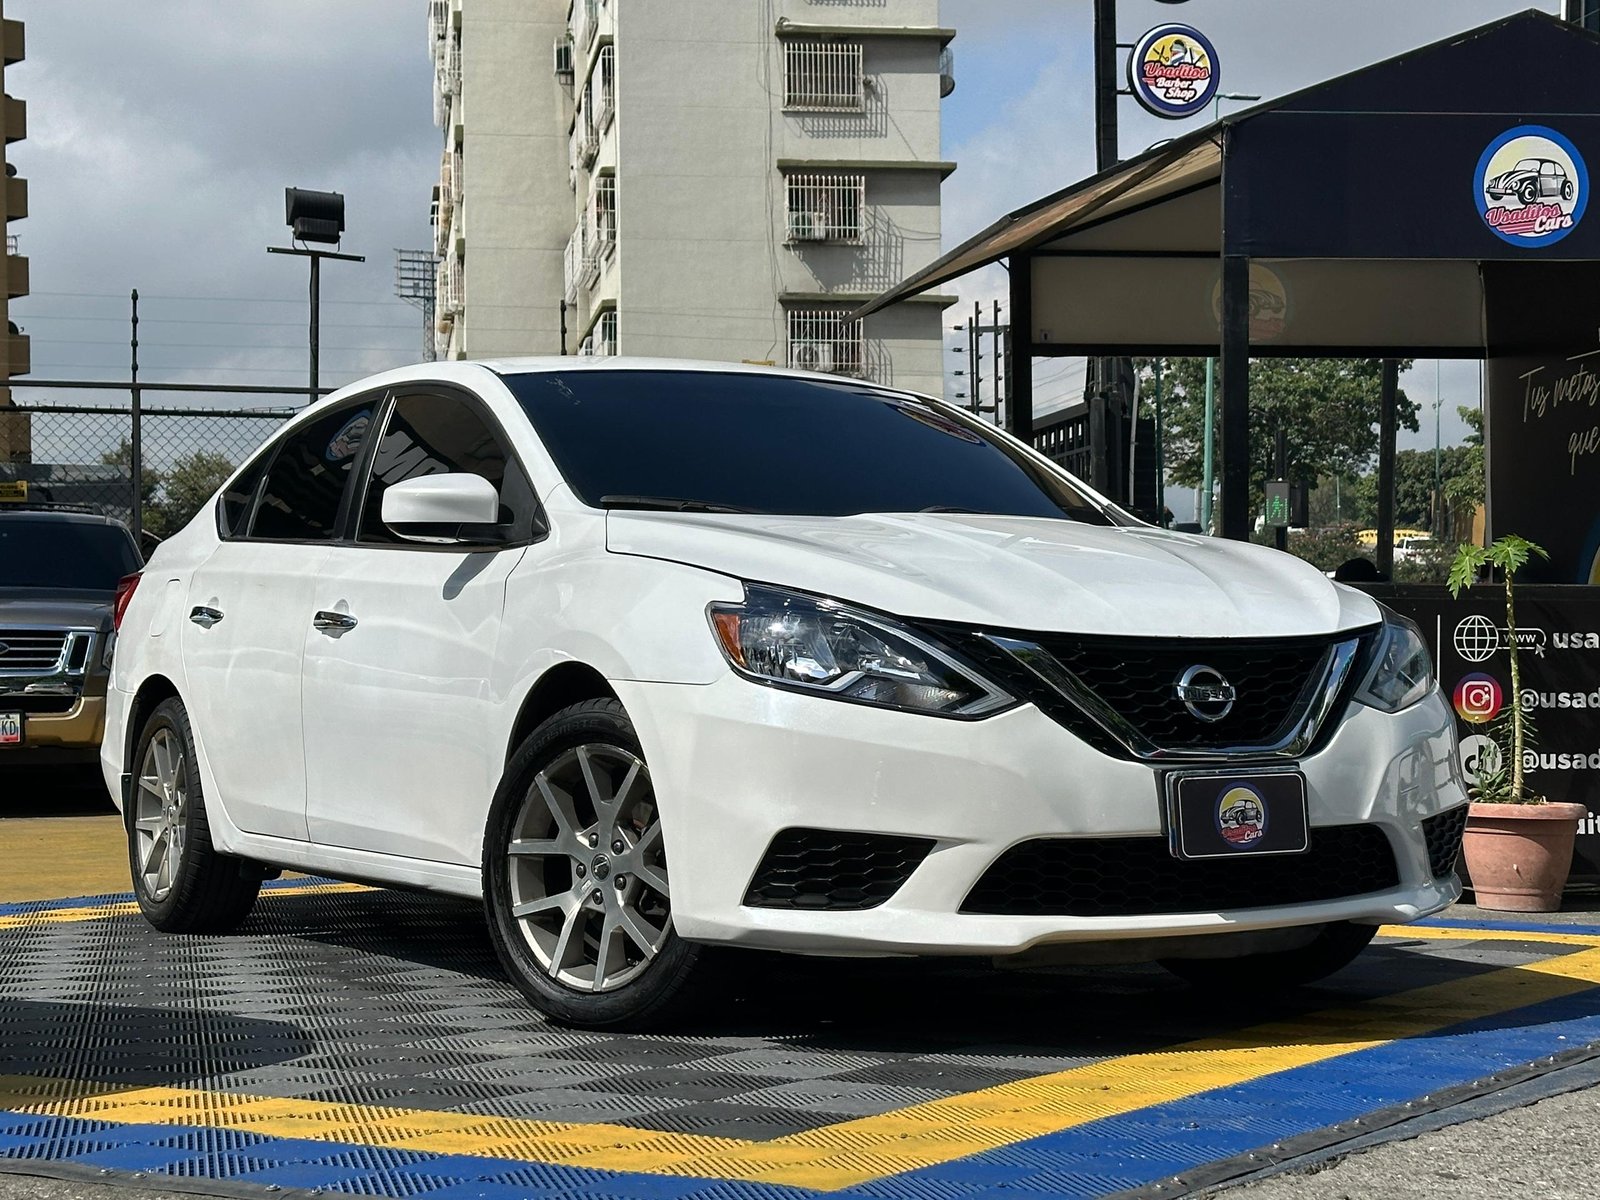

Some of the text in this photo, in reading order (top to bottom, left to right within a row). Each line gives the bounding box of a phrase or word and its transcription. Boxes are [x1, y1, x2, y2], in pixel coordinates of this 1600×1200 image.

[1143, 62, 1209, 79] Usaditos
[1156, 77, 1192, 89] Barber
[1165, 87, 1196, 101] Shop
[1485, 203, 1562, 226] Usaditos
[1533, 214, 1574, 233] Cars
[1519, 363, 1600, 423] Tus metas
[1568, 426, 1600, 476] que
[1552, 632, 1600, 649] usa
[1244, 829, 1264, 840] Cars
